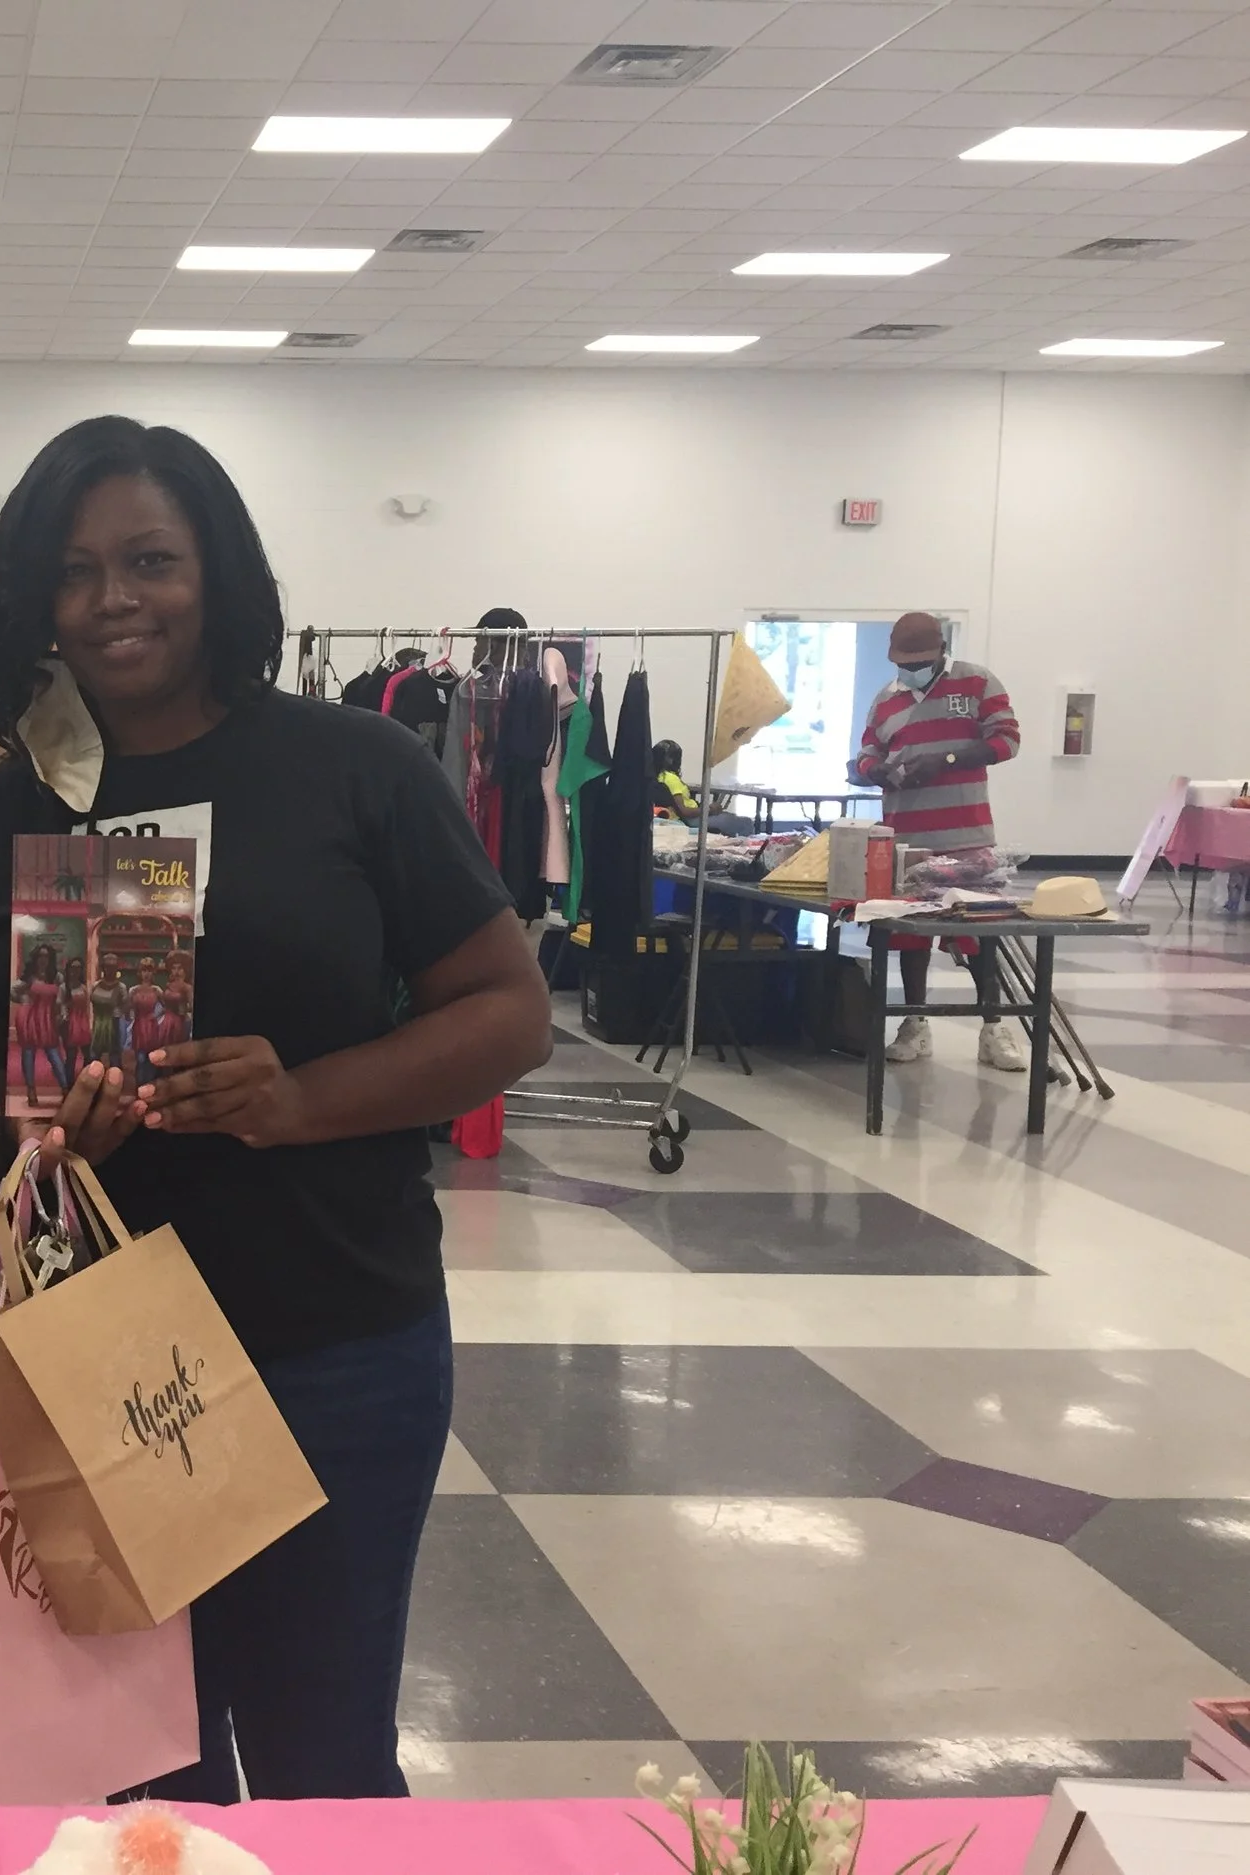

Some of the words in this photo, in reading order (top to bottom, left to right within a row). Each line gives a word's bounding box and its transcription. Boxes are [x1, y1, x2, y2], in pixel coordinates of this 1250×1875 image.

[851, 501, 877, 521] EXIT
[139, 859, 191, 889] Talk
[122, 1344, 205, 1446] thank
[155, 1393, 206, 1477] you
